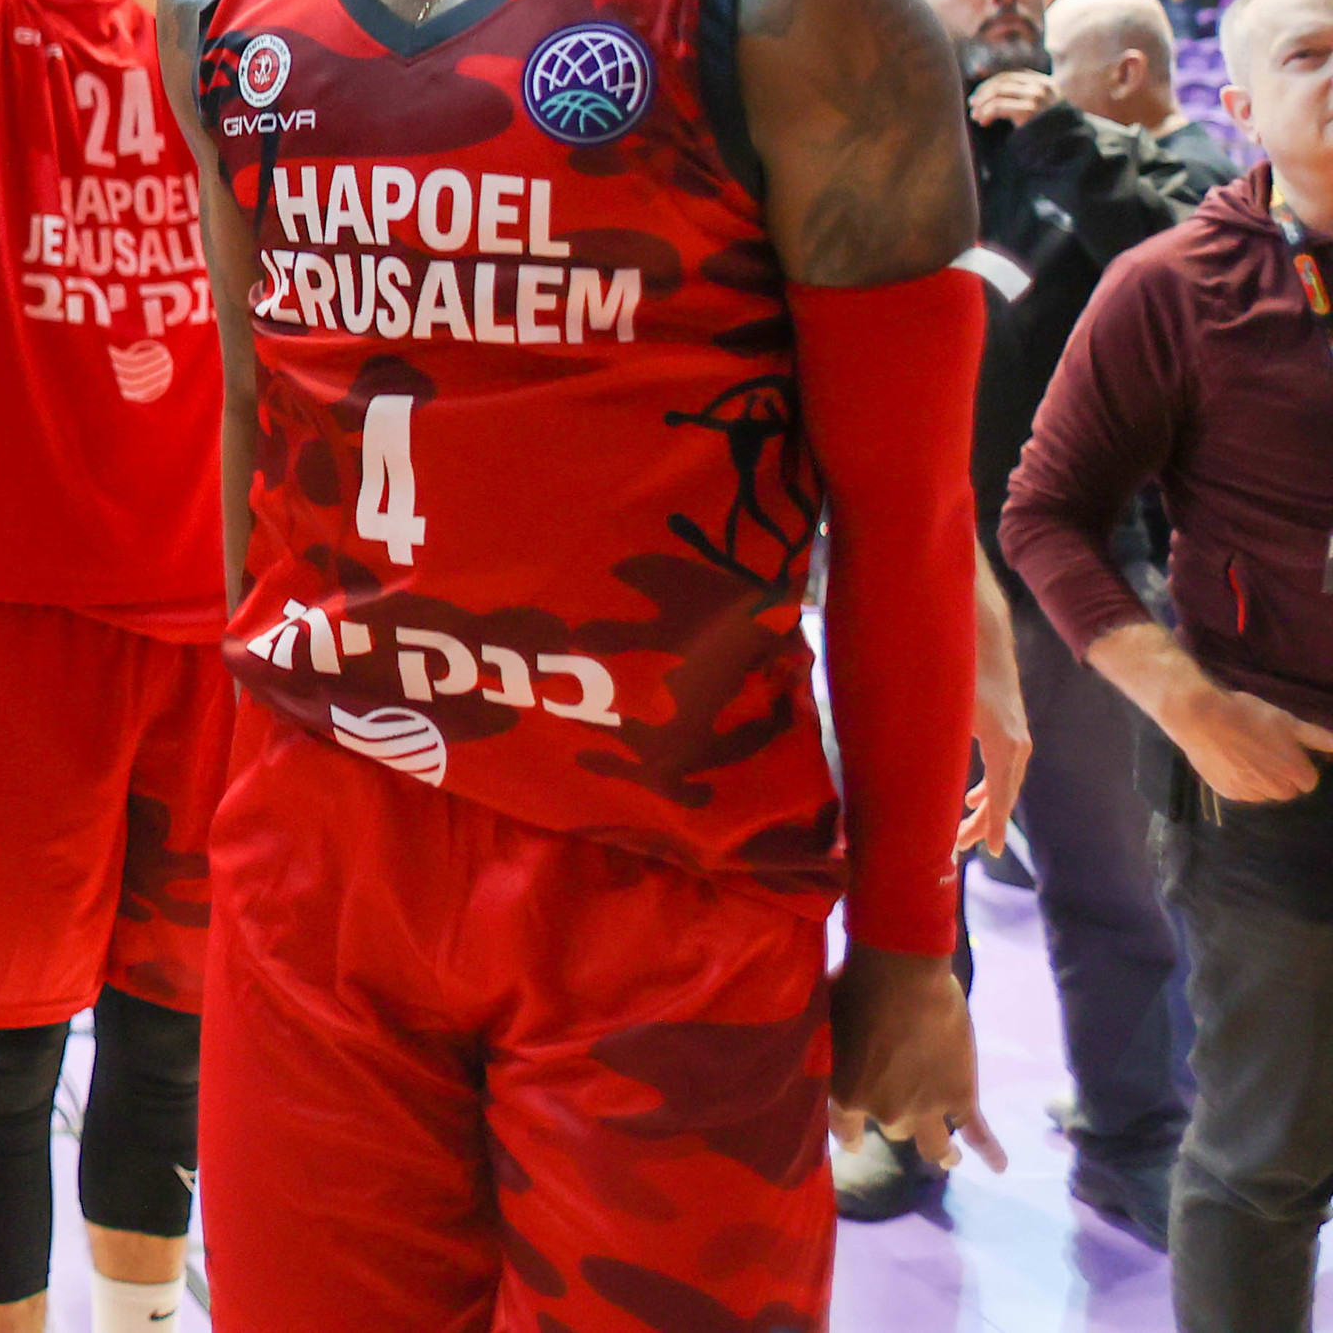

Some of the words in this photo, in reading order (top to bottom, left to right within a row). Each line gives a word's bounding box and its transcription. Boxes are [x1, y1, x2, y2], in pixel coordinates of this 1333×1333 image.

[74, 67, 165, 167] 24
[223, 109, 316, 137] GIVOVA
[273, 164, 571, 258] HAPOEL
[355, 394, 427, 566] 4
[395, 625, 622, 728] בנק
